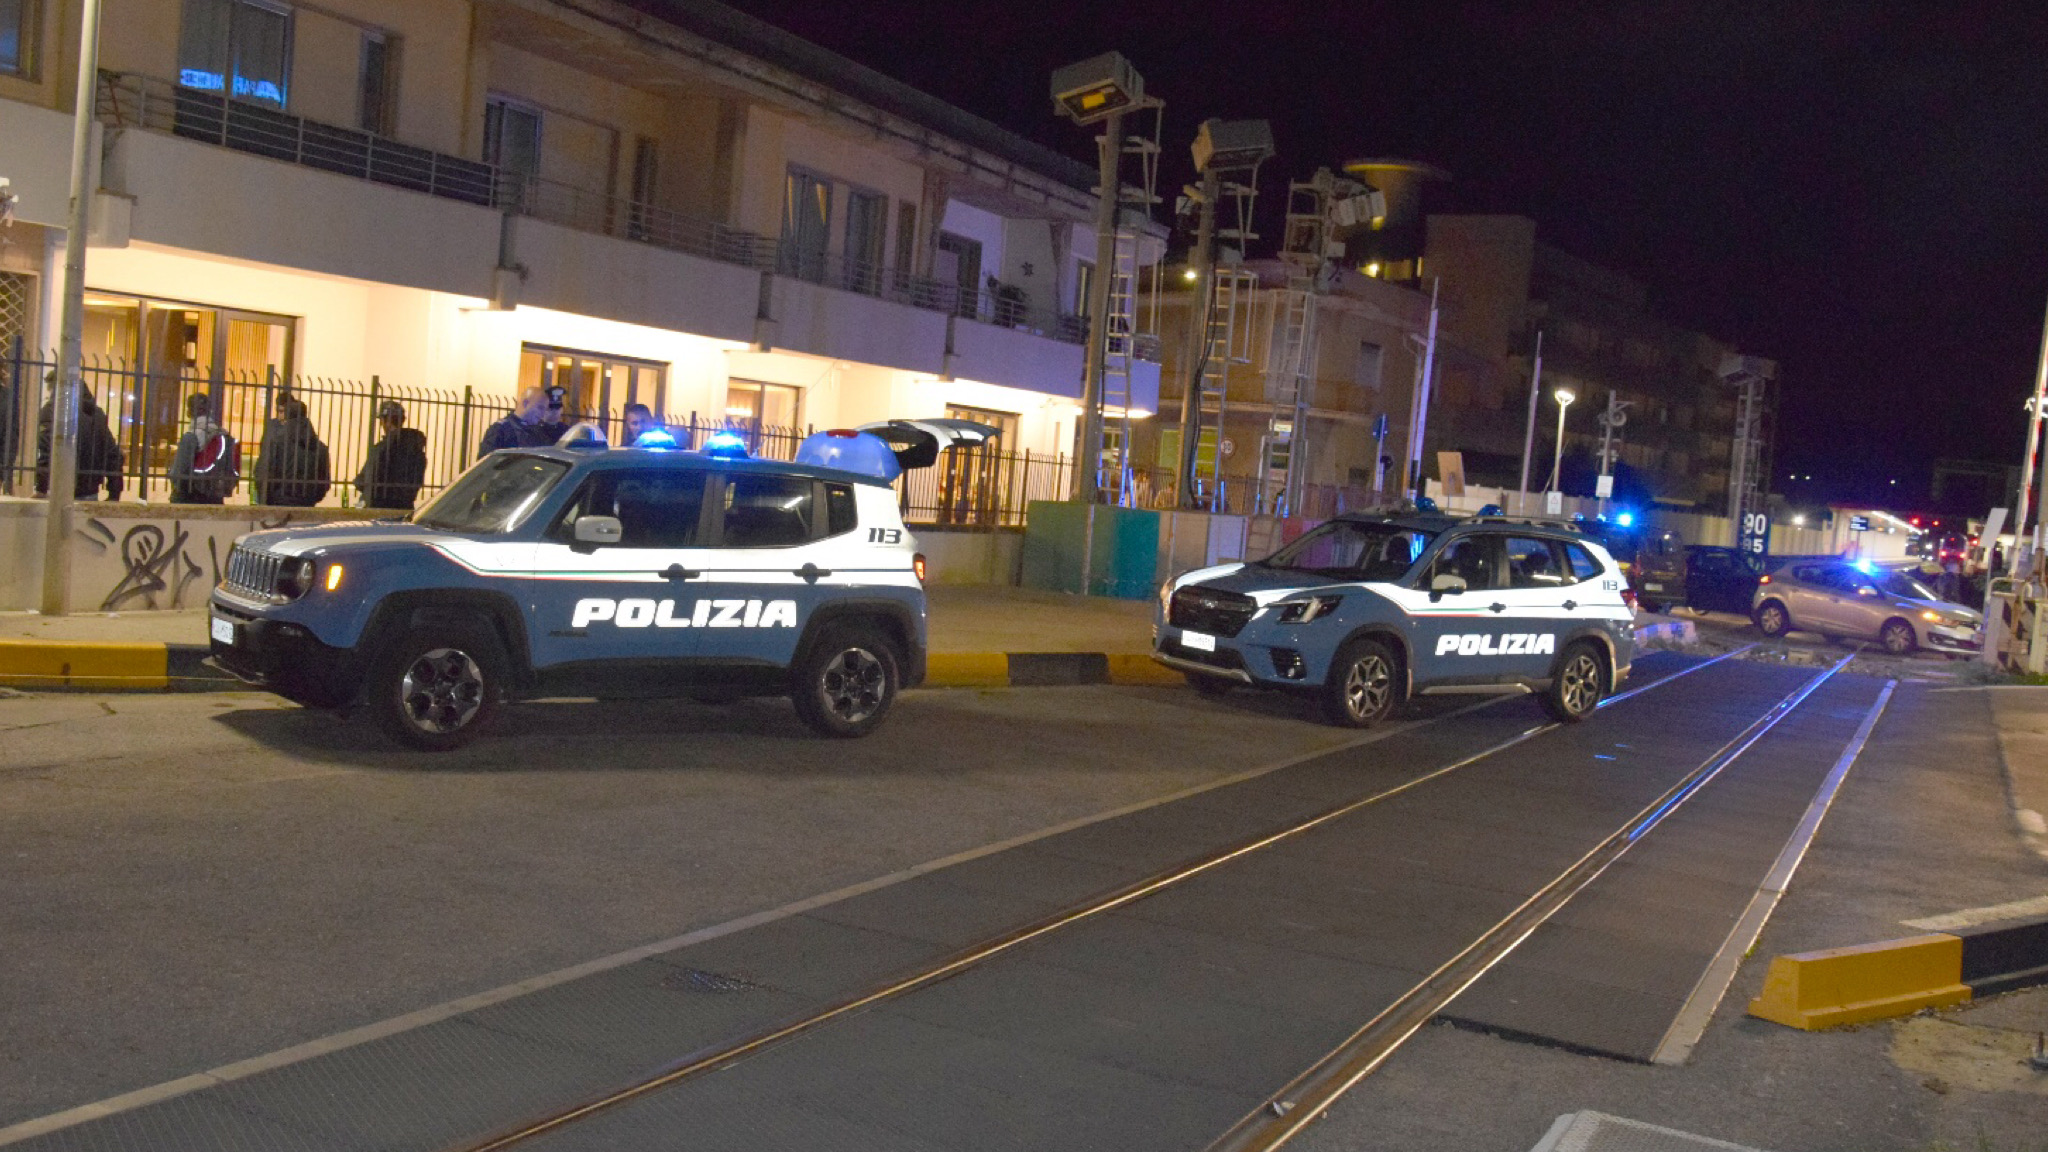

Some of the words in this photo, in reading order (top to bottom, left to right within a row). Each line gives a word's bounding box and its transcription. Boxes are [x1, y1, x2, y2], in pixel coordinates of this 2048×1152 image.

[1743, 513, 1766, 535] 90
[869, 528, 901, 544] 113
[1603, 580, 1618, 591] 113
[572, 598, 796, 628] POLIZIA
[1435, 633, 1555, 656] POLIZIA
